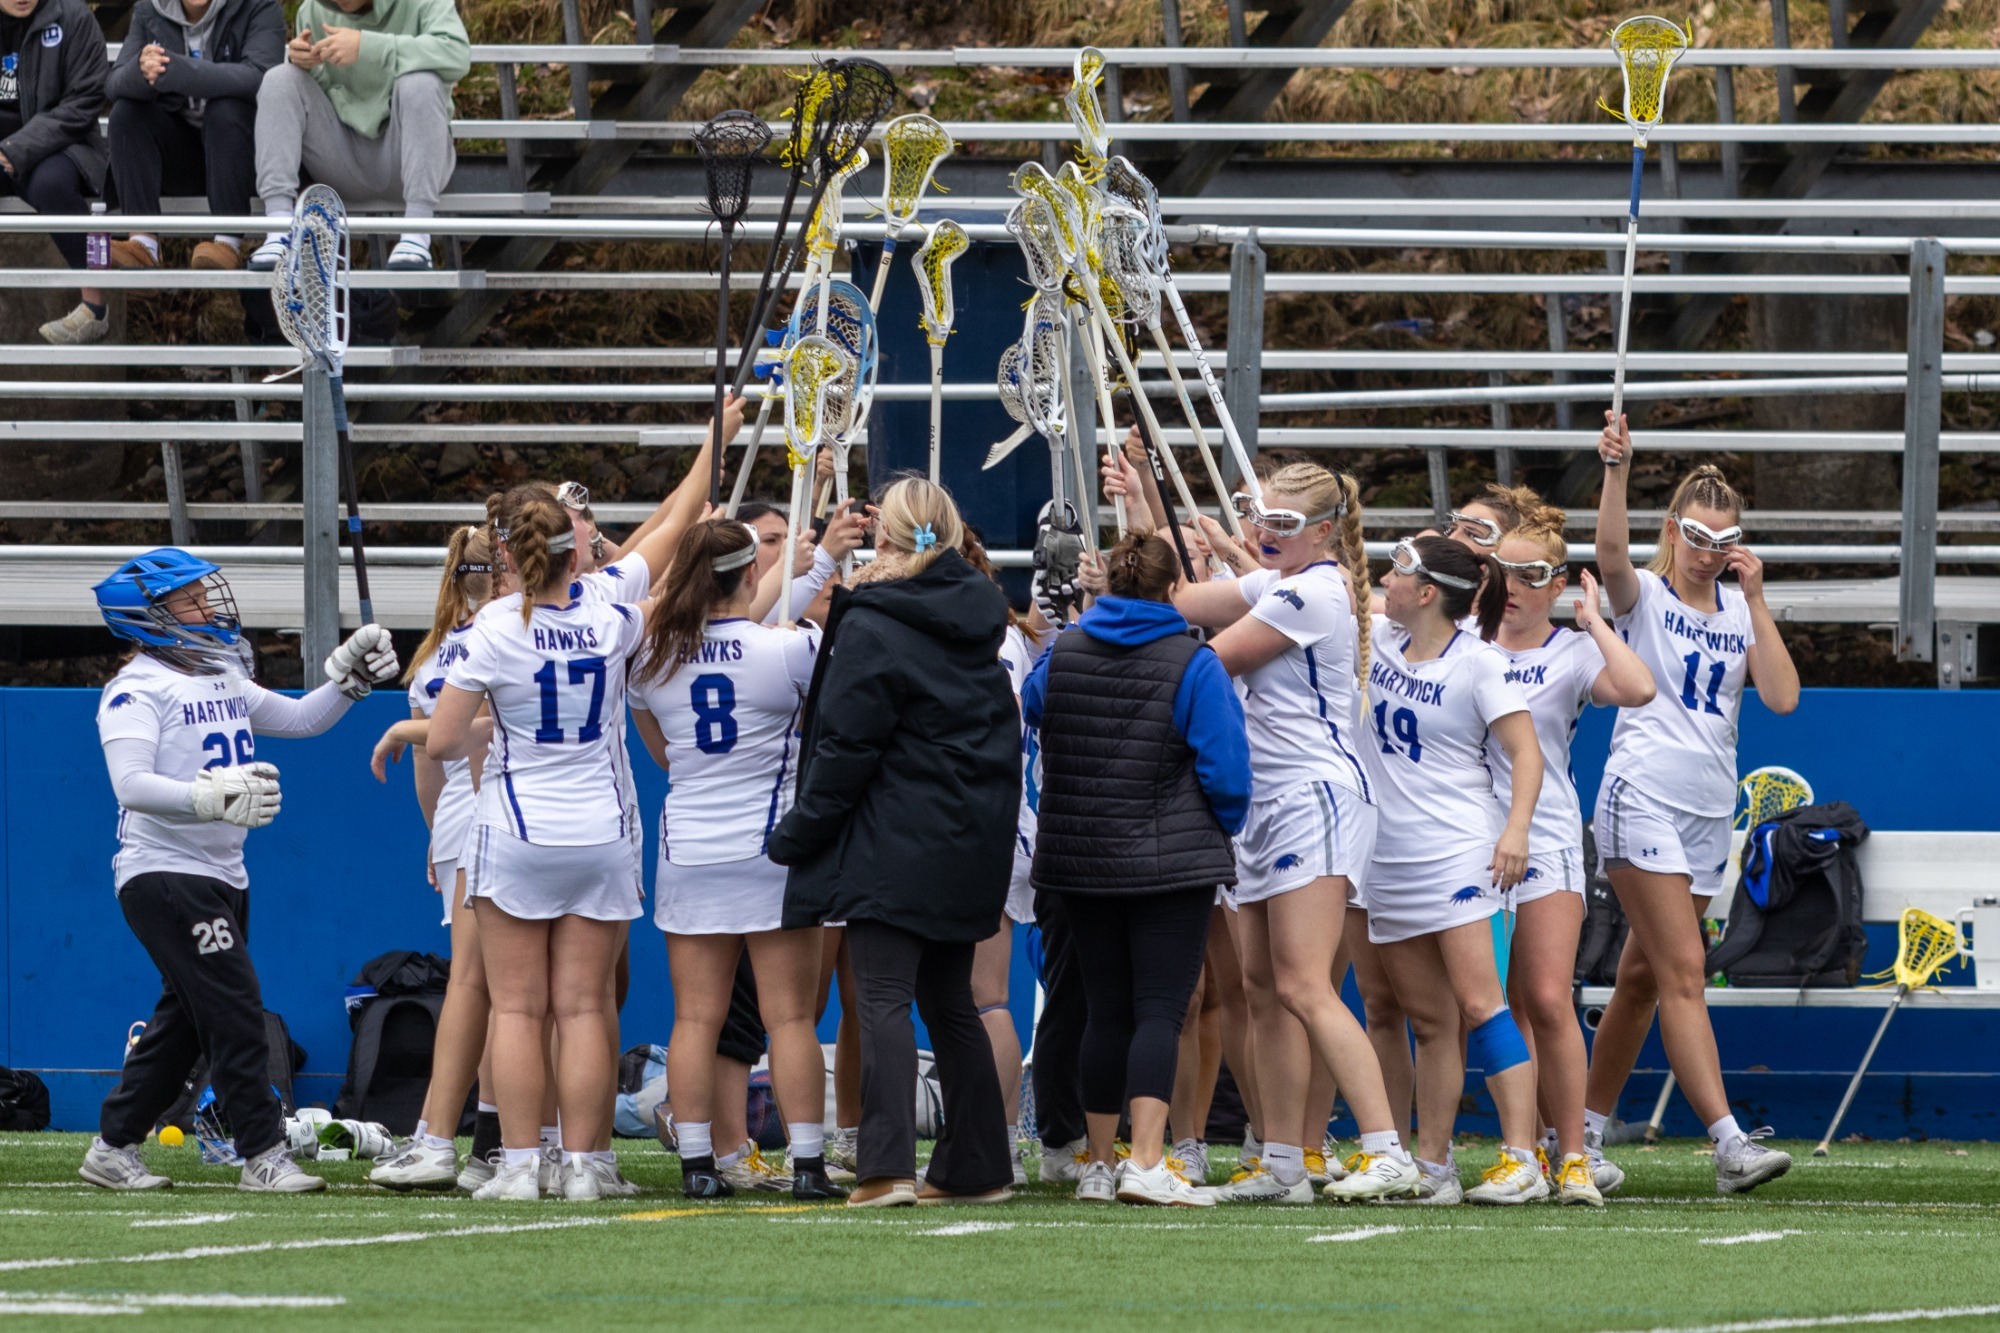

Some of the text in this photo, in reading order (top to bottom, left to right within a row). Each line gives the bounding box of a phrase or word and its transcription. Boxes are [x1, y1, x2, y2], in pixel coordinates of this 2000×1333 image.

[534, 627, 598, 650] HAWKS
[1664, 610, 1746, 655] HARTWICK
[533, 656, 608, 744] 17
[1369, 661, 1446, 707] HARTWICK
[1679, 651, 1726, 717] 11
[690, 673, 738, 755] 8
[1374, 700, 1422, 764] 19
[192, 917, 234, 955] 26
[1232, 1193, 1250, 1202] new
